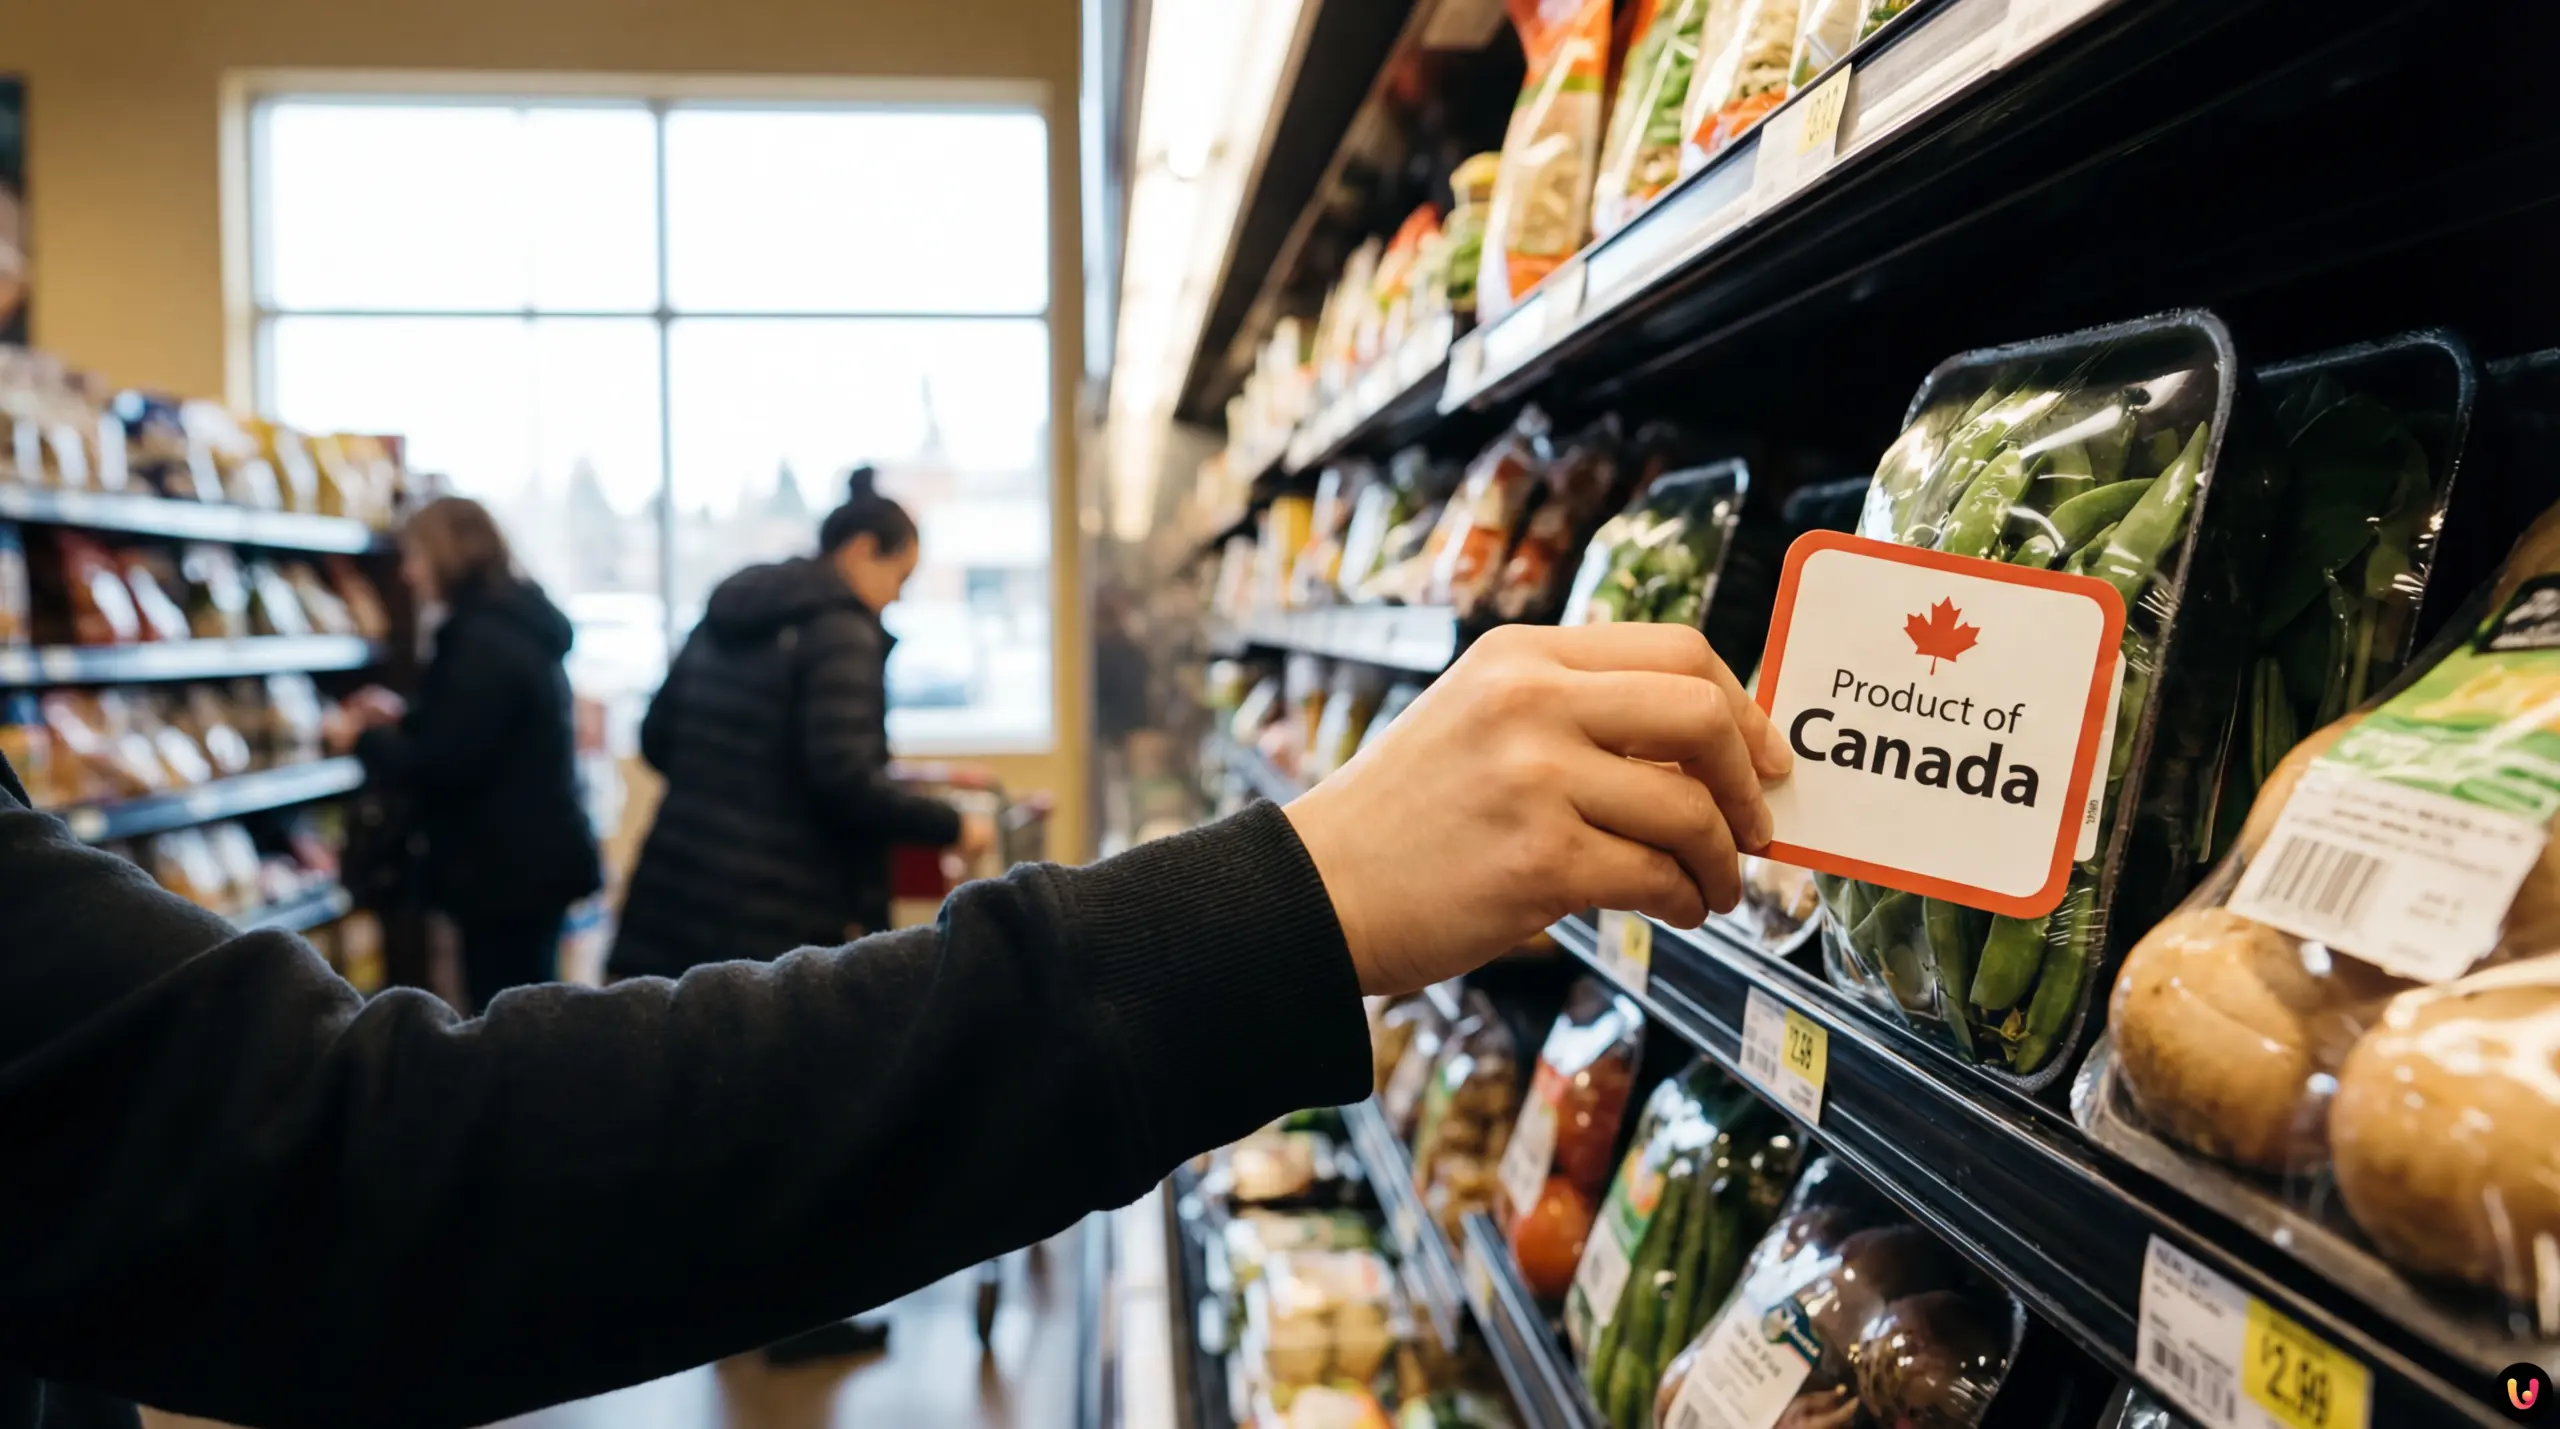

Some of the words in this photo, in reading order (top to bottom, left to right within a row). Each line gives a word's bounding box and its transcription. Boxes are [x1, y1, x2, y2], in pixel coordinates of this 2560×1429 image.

[1832, 668, 1974, 726] Product
[1983, 702, 2026, 734] of
[1789, 707, 2040, 808] Canada
